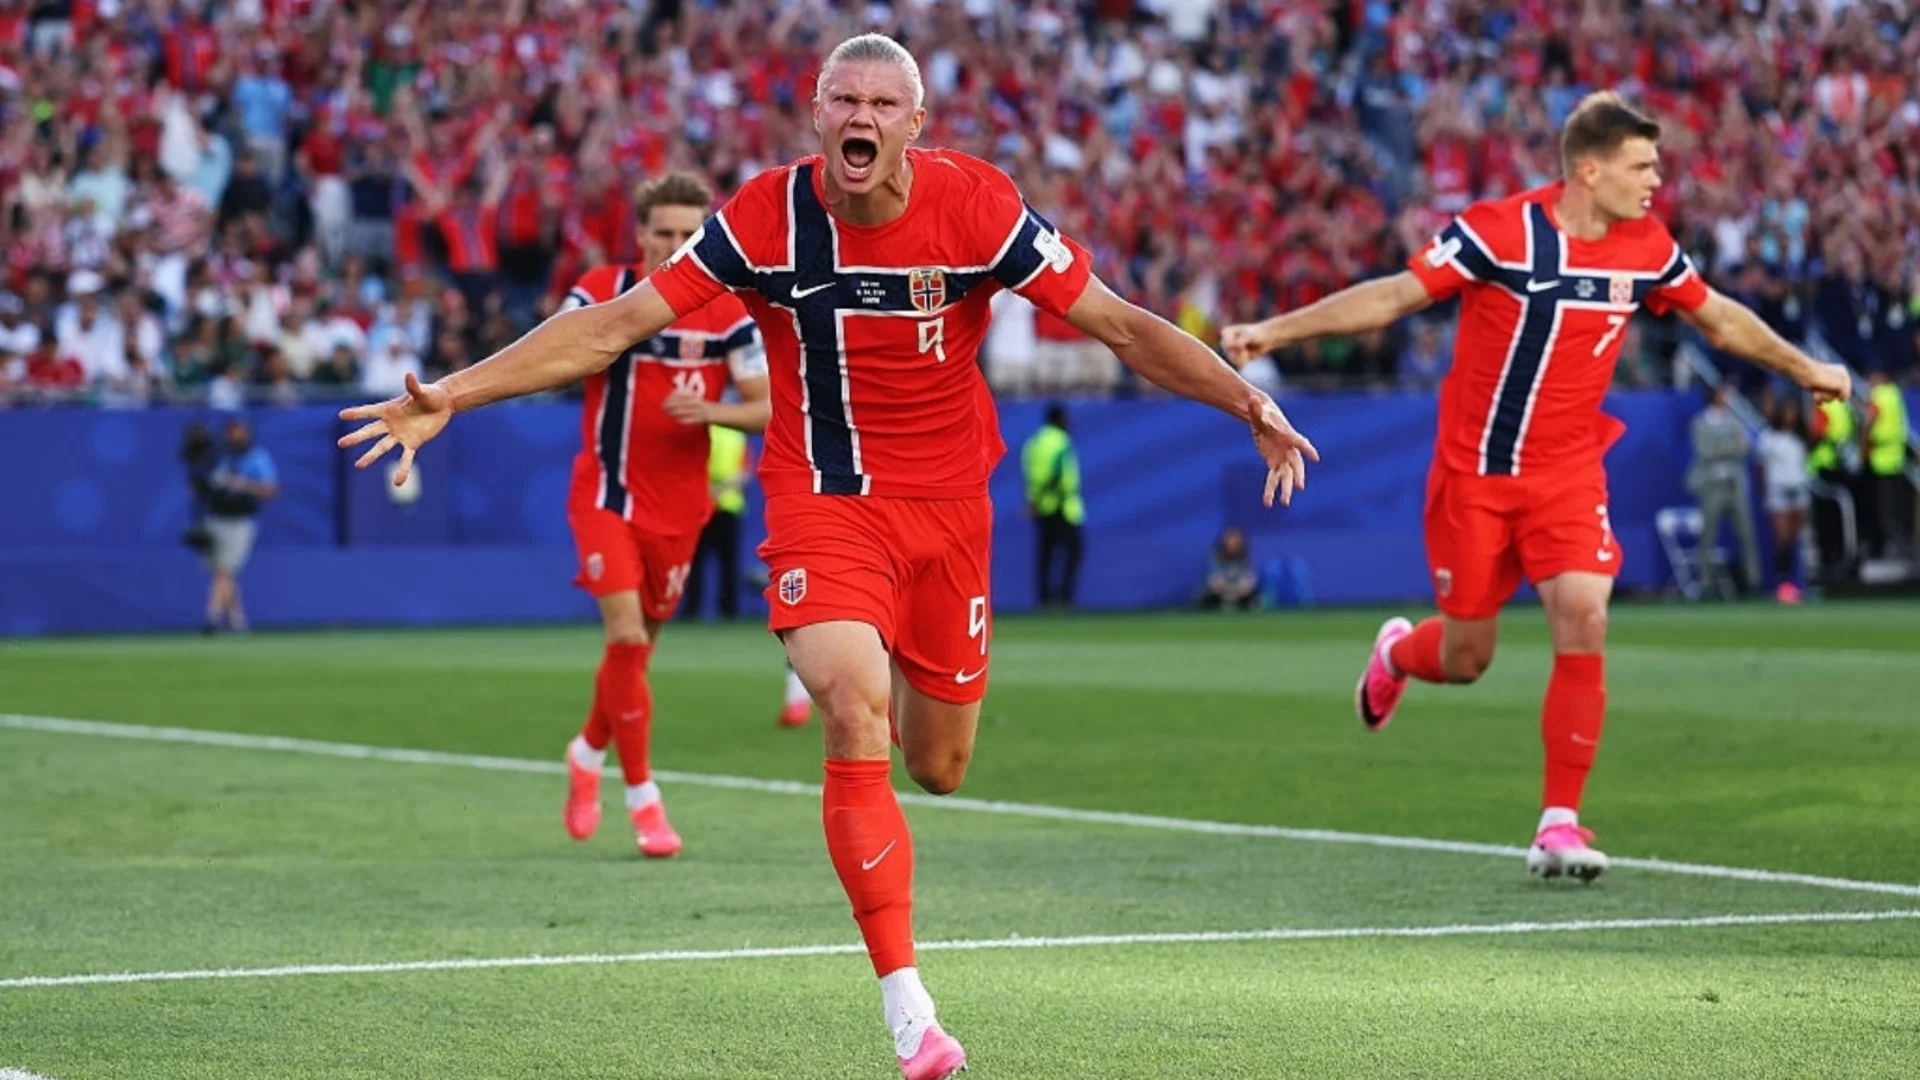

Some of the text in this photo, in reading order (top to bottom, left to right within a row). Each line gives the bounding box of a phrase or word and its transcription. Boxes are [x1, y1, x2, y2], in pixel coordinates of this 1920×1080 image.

[918, 316, 946, 362] 9
[1592, 314, 1626, 357] 7
[968, 596, 987, 656] 9
